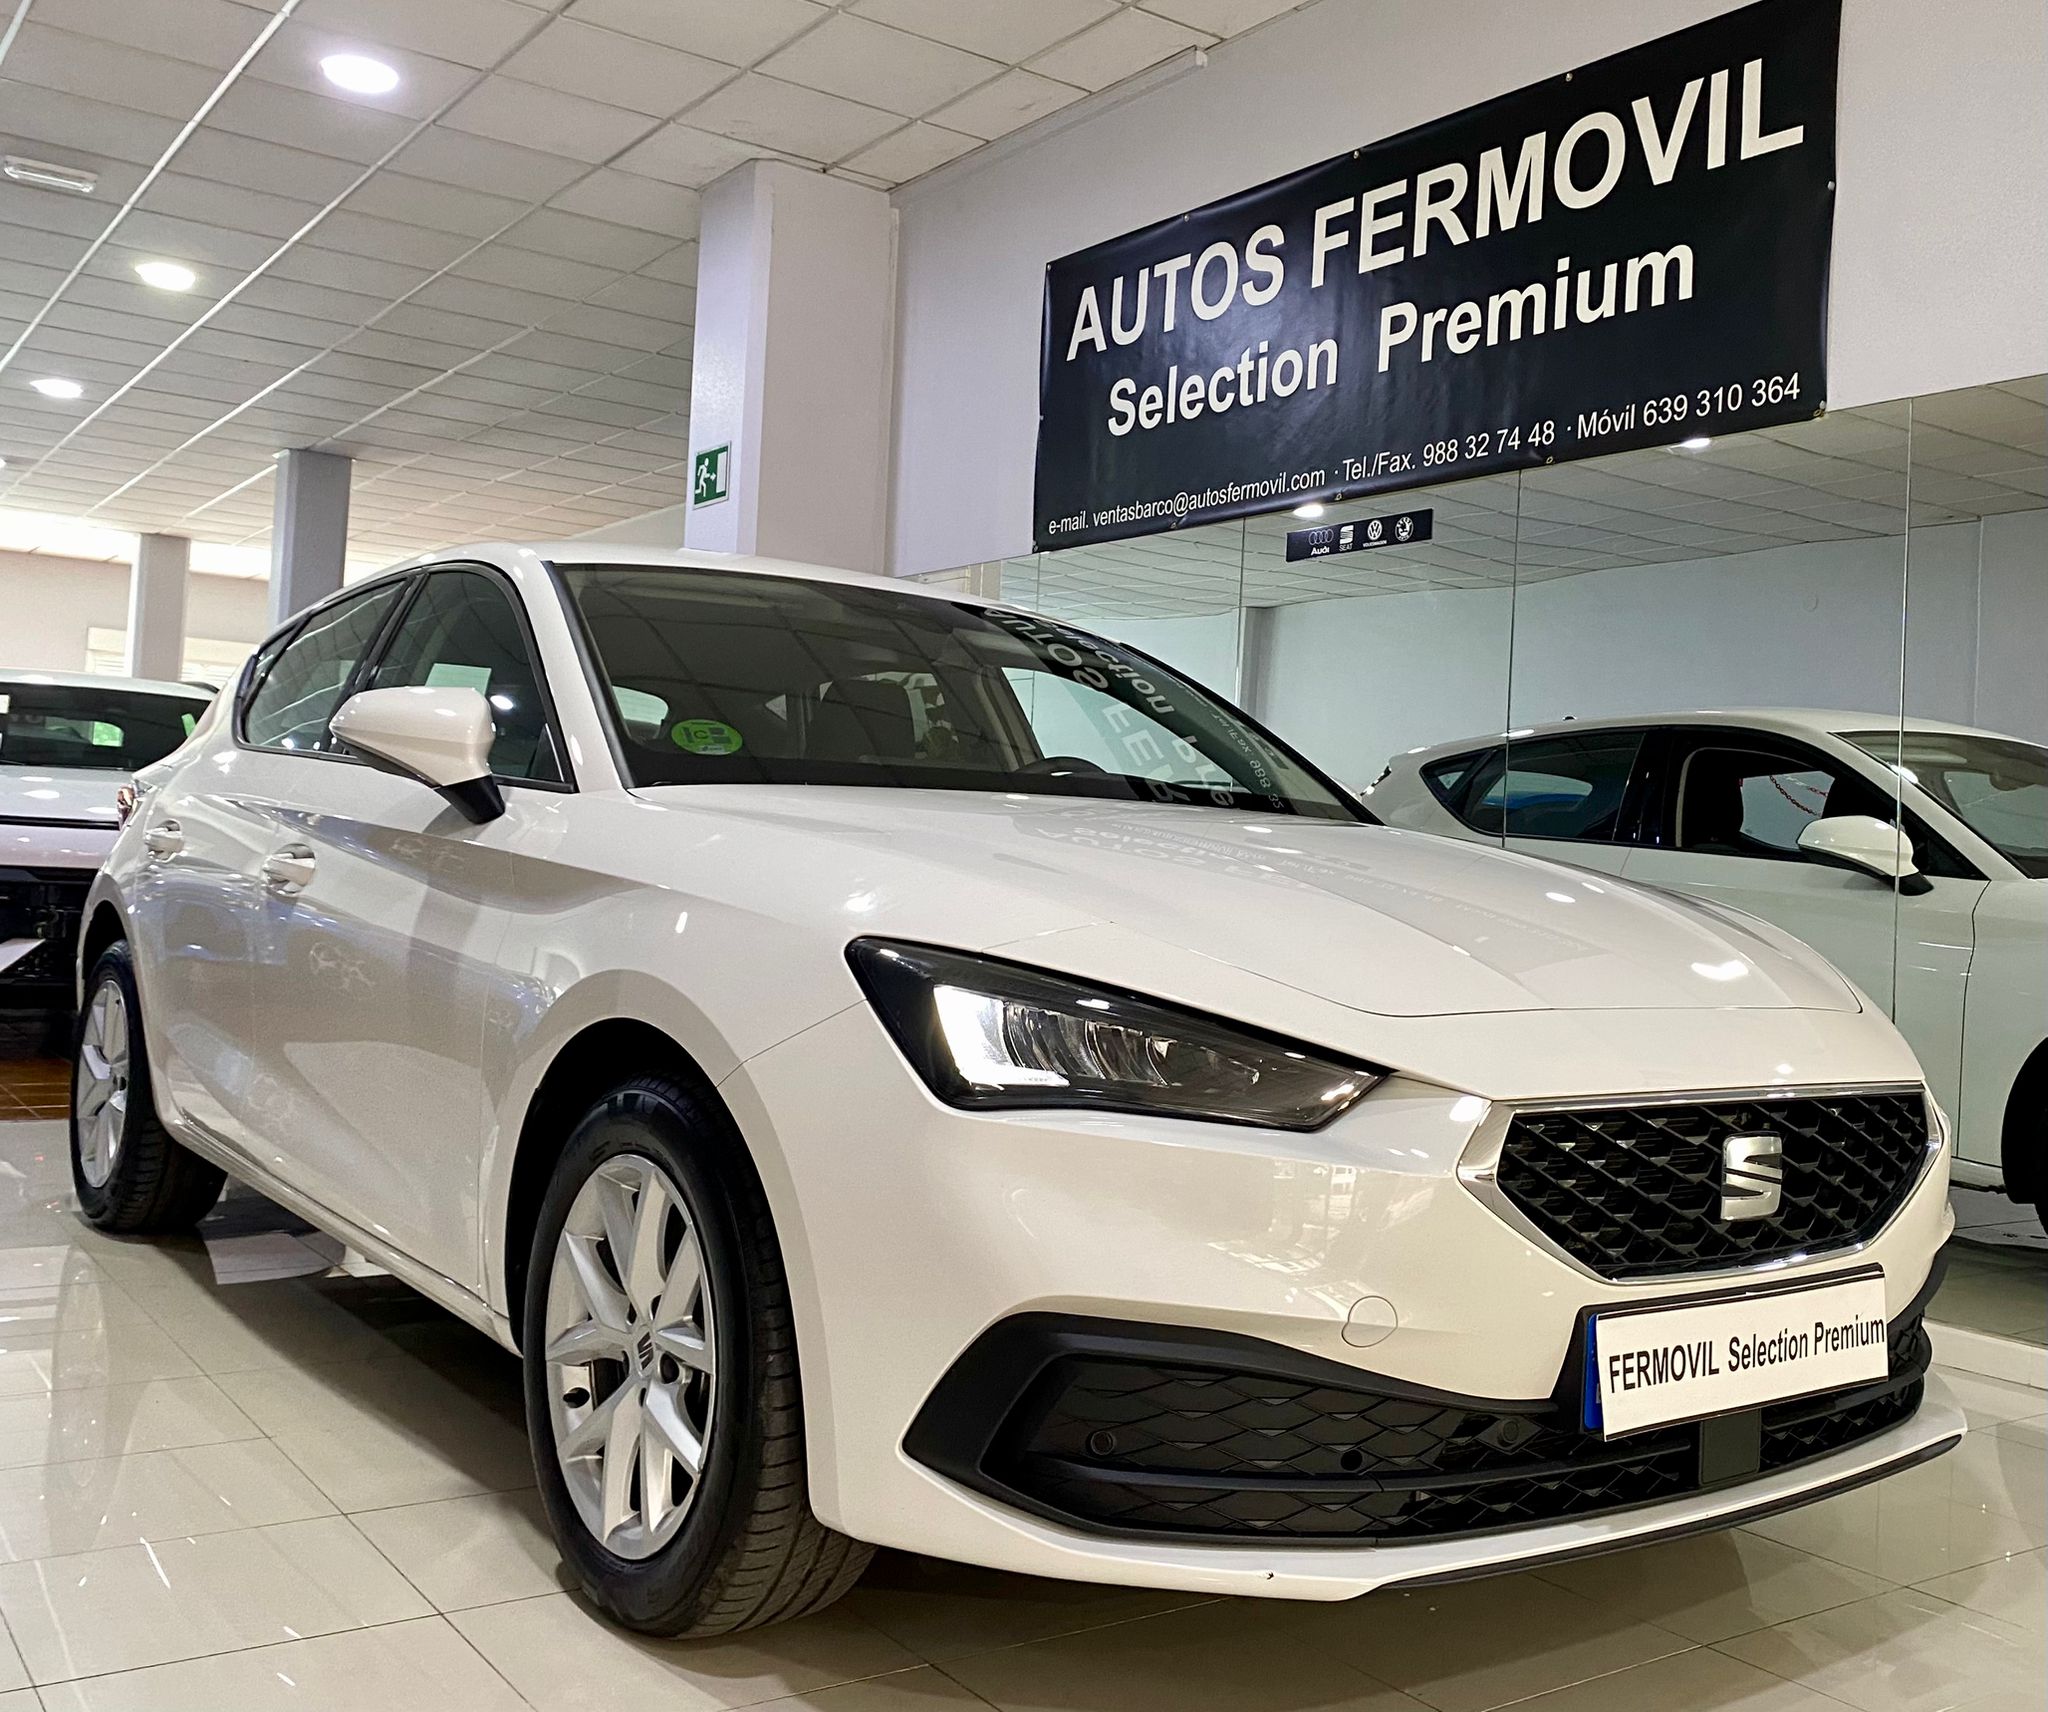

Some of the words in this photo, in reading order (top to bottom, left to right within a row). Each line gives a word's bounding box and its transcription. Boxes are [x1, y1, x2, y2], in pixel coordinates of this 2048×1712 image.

[1067, 225, 1285, 361] AUTOS
[1311, 59, 1804, 289] FERMOVIL
[1108, 337, 1338, 436] Selection
[1378, 245, 1694, 372] Premium
[1049, 510, 1090, 535] e-mail.
[1093, 469, 1325, 527] ventasbarco@autosfermovil.com
[1424, 439, 1458, 467] 988
[1465, 433, 1490, 460] 32
[1497, 426, 1521, 454] 74
[1528, 420, 1555, 447] 48
[1577, 403, 1636, 440] Móvil
[1643, 395, 1688, 427] 639
[1696, 384, 1743, 417] 310
[1752, 372, 1801, 407] 364
[1310, 546, 1330, 556] Audi
[1339, 543, 1353, 552] SEAT
[1609, 1340, 1720, 1394] FERMOVIL
[1728, 1327, 1808, 1372] Selection
[1814, 1314, 1885, 1355] Premium
